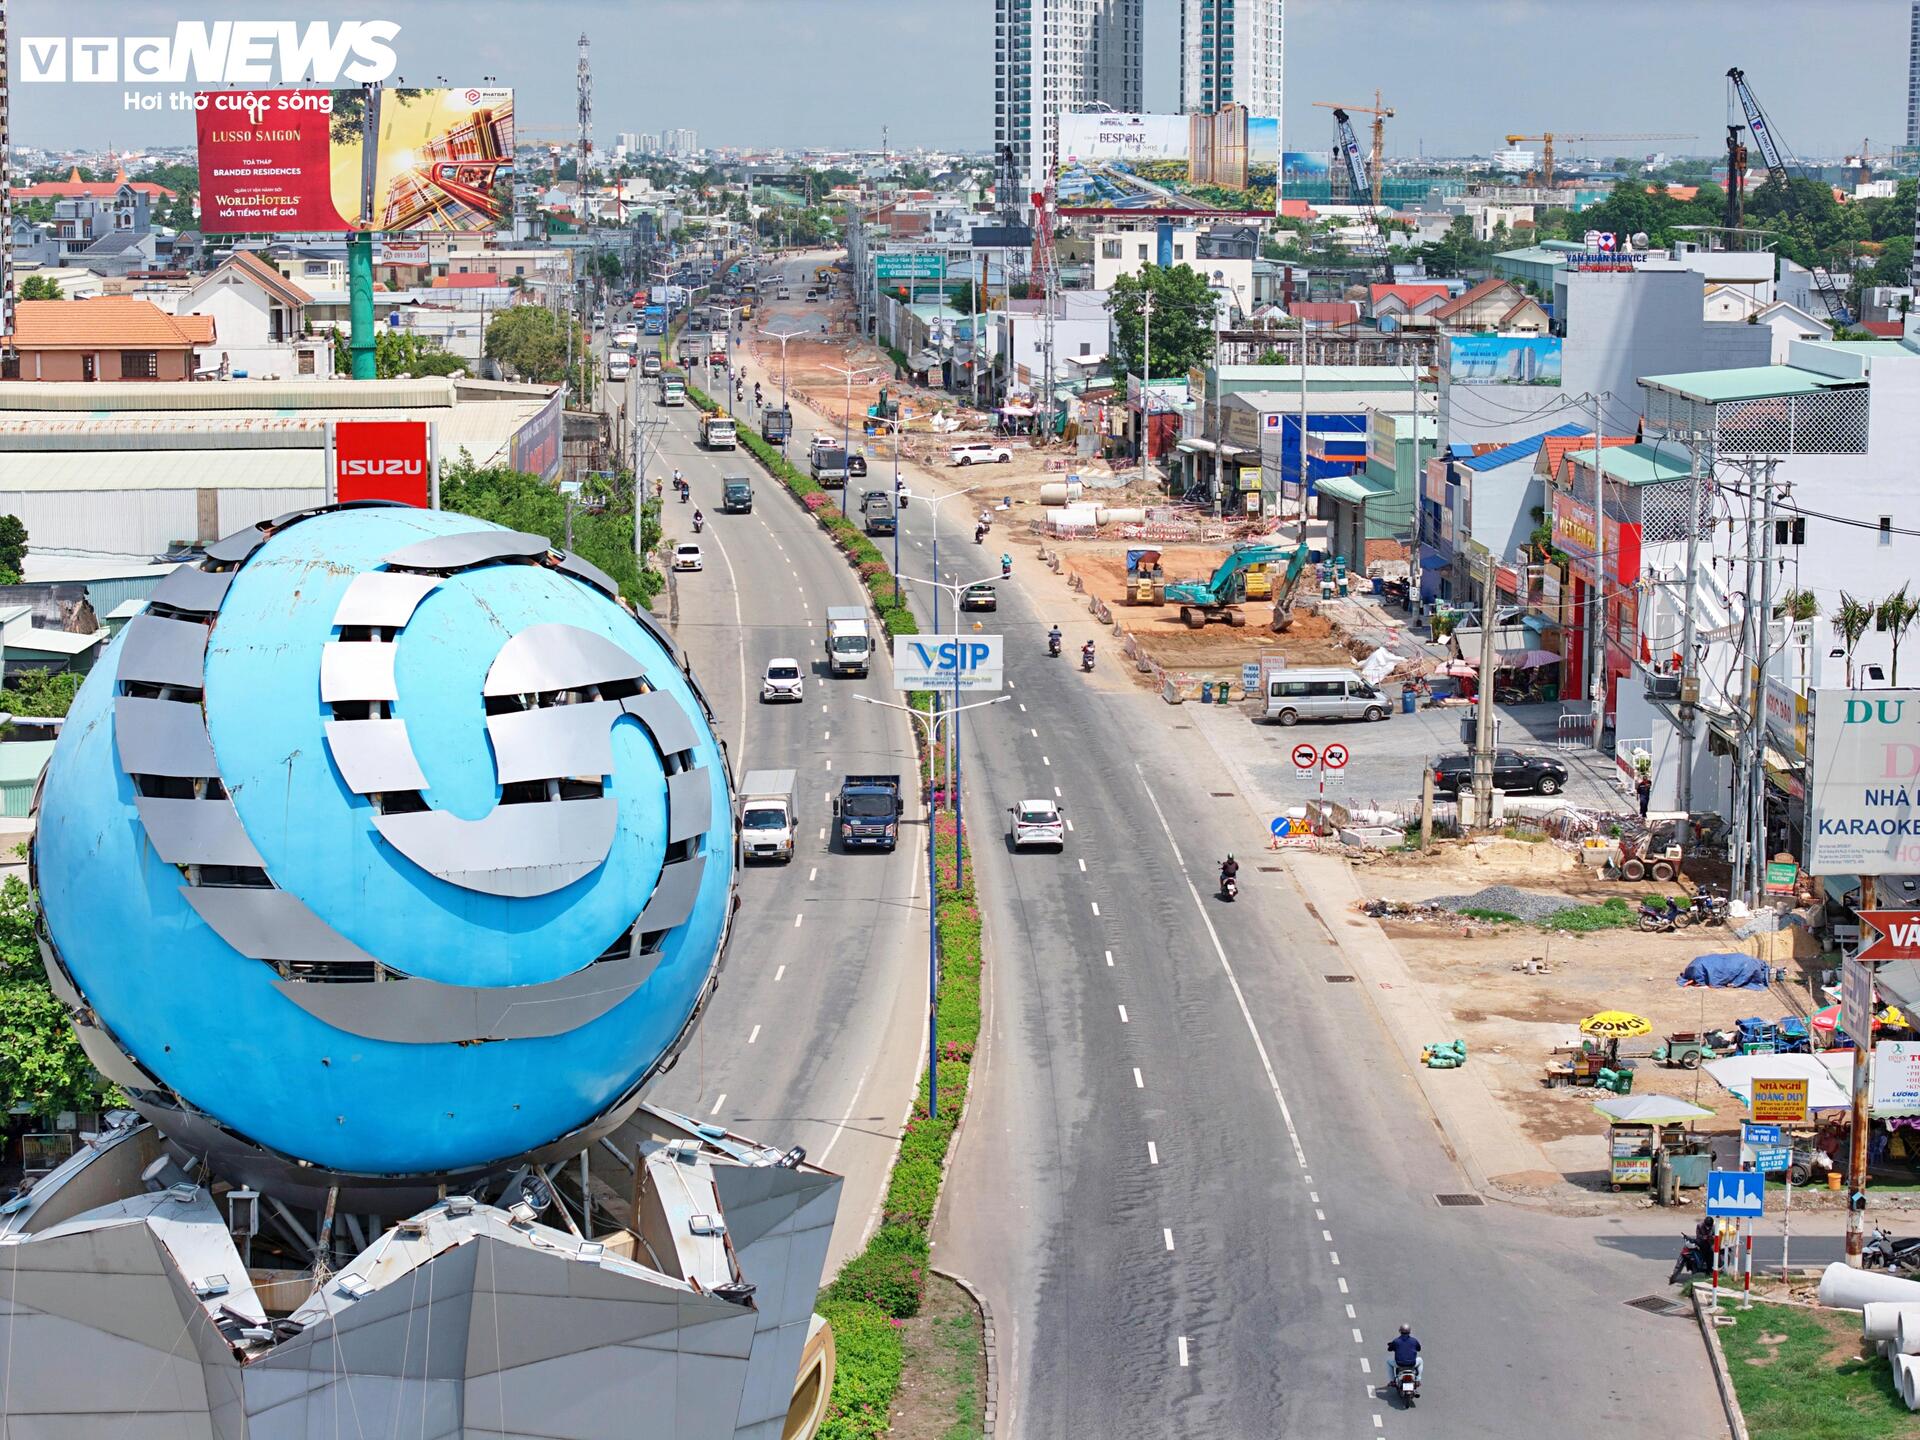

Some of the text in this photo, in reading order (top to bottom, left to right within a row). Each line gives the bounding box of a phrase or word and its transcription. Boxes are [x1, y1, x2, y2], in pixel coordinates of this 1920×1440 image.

[212, 129, 301, 143] LUSSO SAIGON
[213, 167, 302, 177] BRANDED RESIDENCES
[236, 207, 260, 217] TIẾNG
[262, 206, 278, 216] THẾ
[1611, 254, 1648, 263] SERVICE
[341, 459, 422, 475] ISUZU
[908, 643, 990, 670] VSIP
[1844, 700, 1904, 724] DU
[1865, 785, 1910, 806] NHÀ
[1760, 1080, 1802, 1090] NHÀ NGHỈ
[1755, 1091, 1804, 1101] HOÀNG DUY
